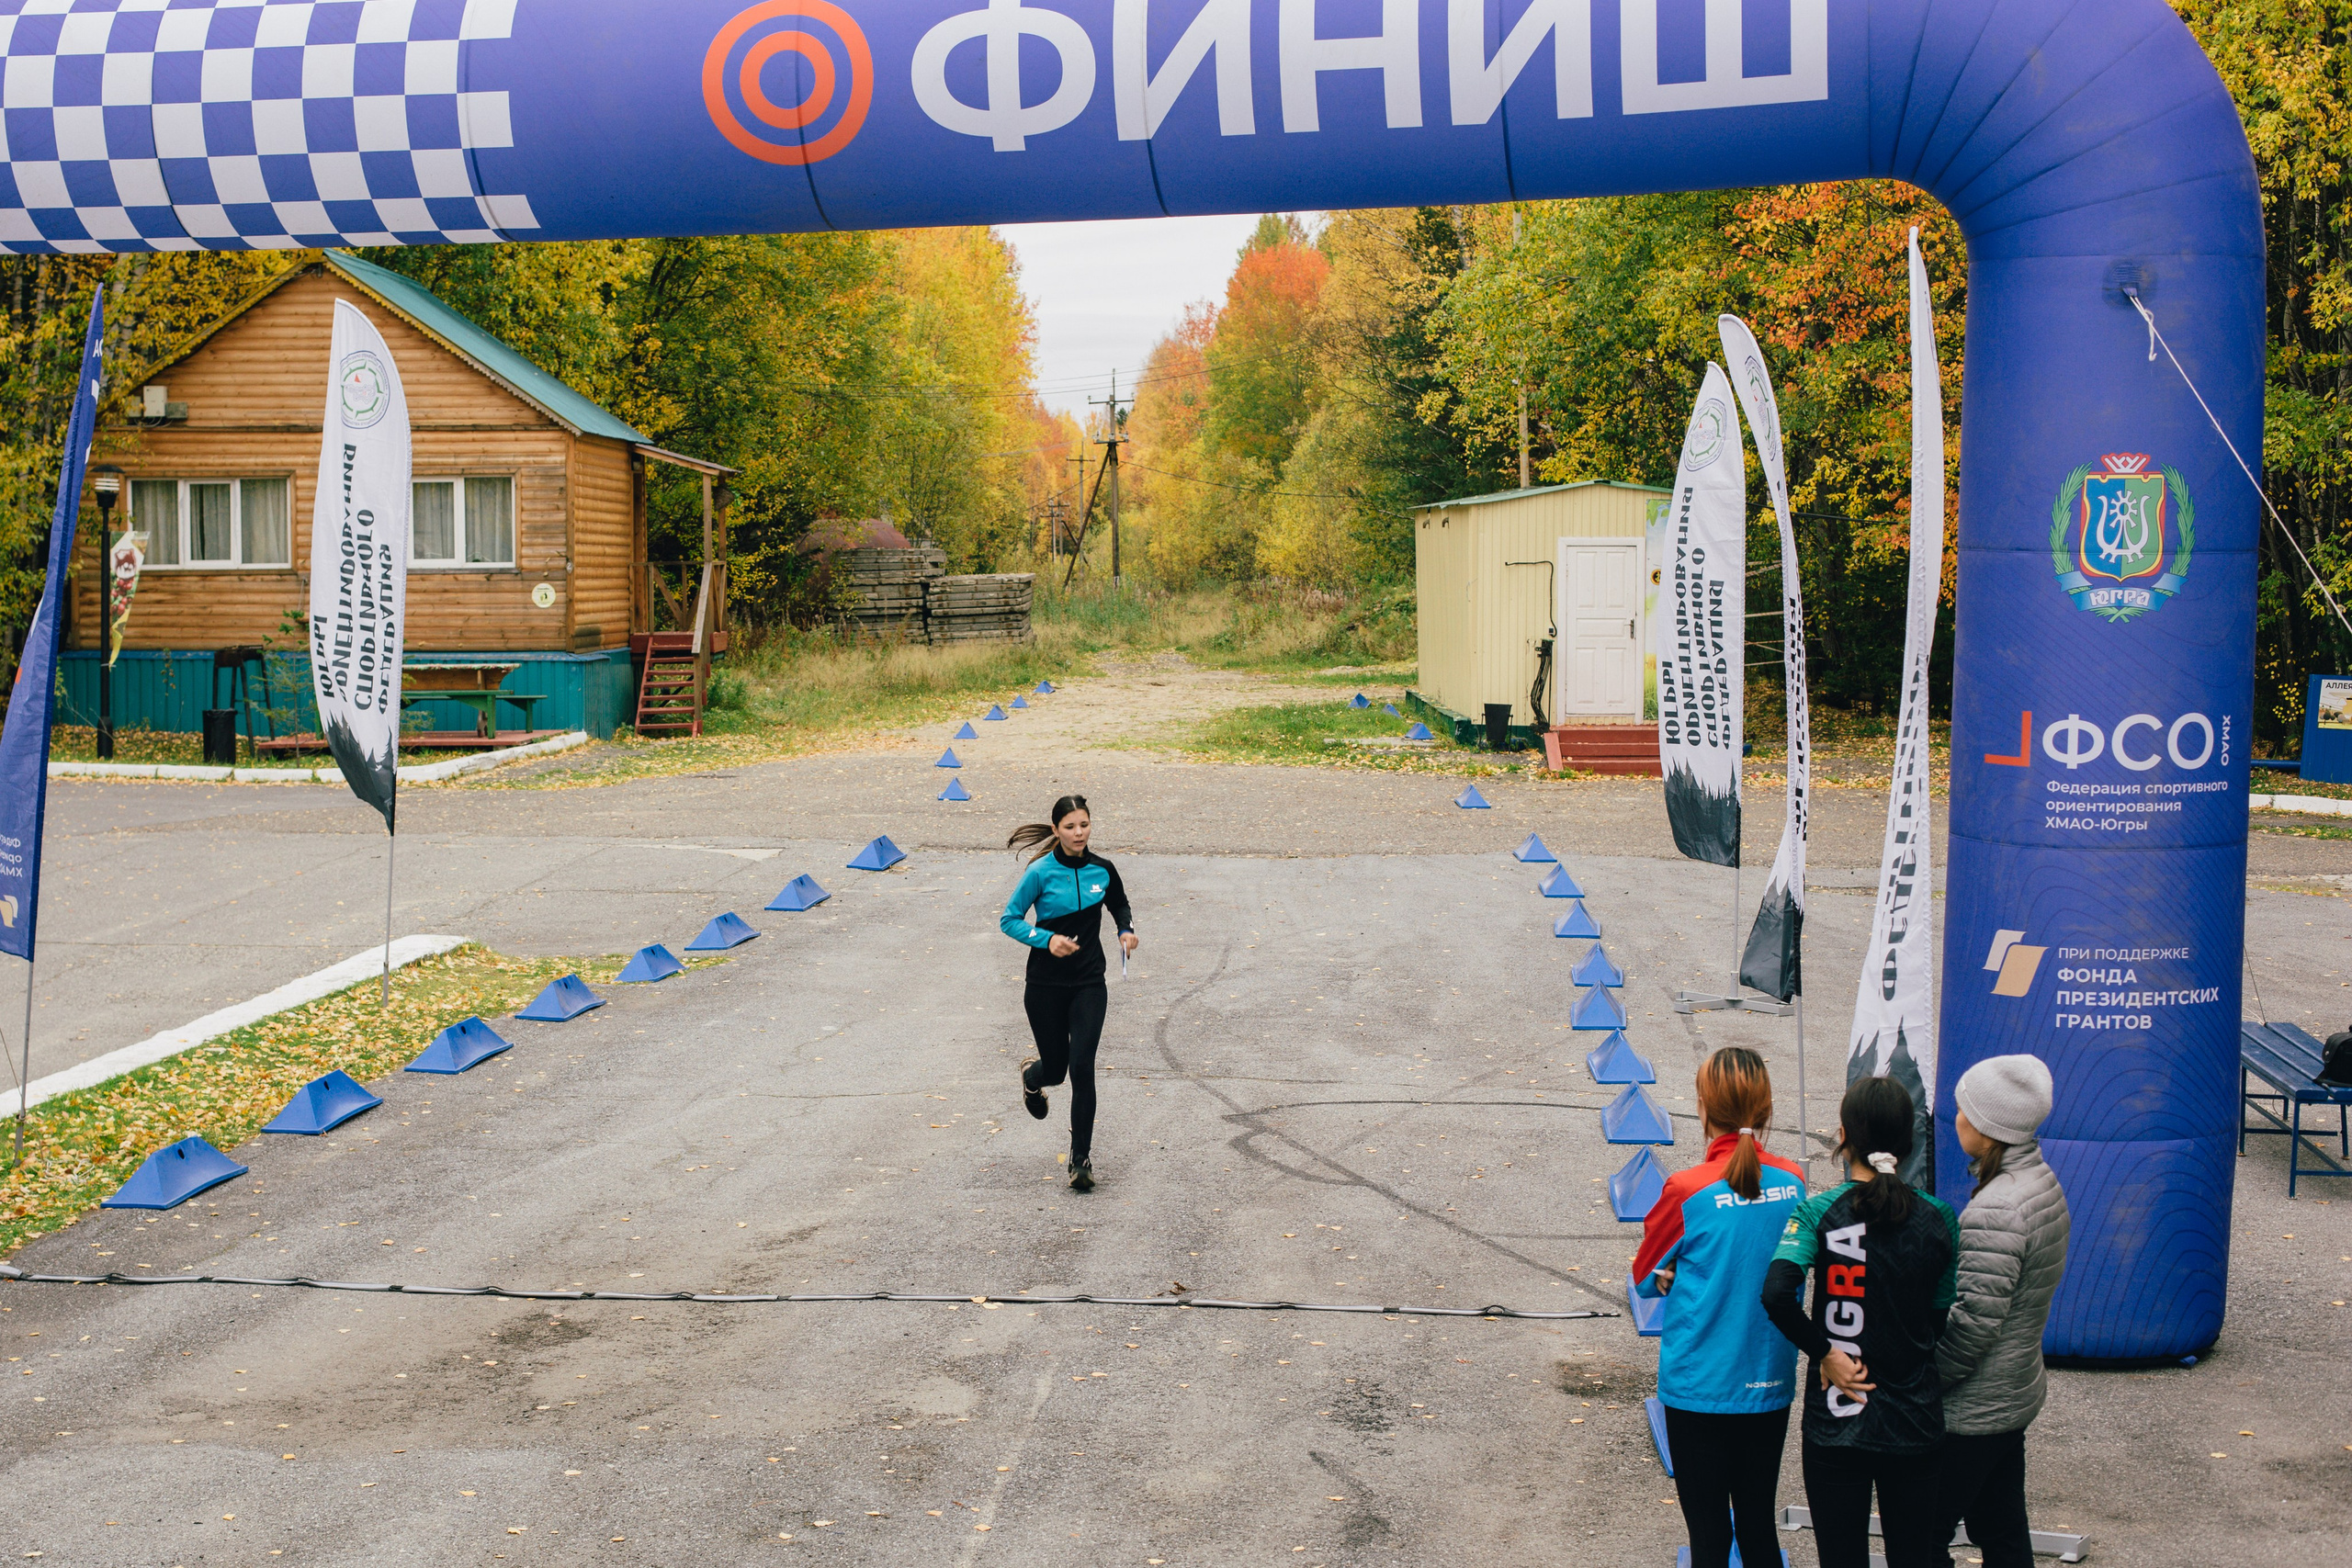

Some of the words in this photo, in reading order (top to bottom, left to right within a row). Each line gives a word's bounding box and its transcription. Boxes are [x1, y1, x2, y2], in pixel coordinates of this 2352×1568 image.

[910, 0, 1828, 152] ФИНИШ
[2041, 712, 2214, 771] ФСО
[2220, 715, 2231, 767] ХМАО
[2046, 780, 2141, 796] Федерация
[2144, 780, 2228, 795] спортивного
[2045, 800, 2182, 816] ориентирования
[2044, 817, 2148, 833] ХМАО-Югры
[2058, 947, 2090, 960] ПРИ
[2095, 947, 2189, 962] ПОДДЕРЖКЕ
[2057, 967, 2138, 986] ФОНДА
[2056, 987, 2220, 1010] ПРЕЗИДЕНТСКИХ
[2055, 1013, 2153, 1030] ГРАНТОВ
